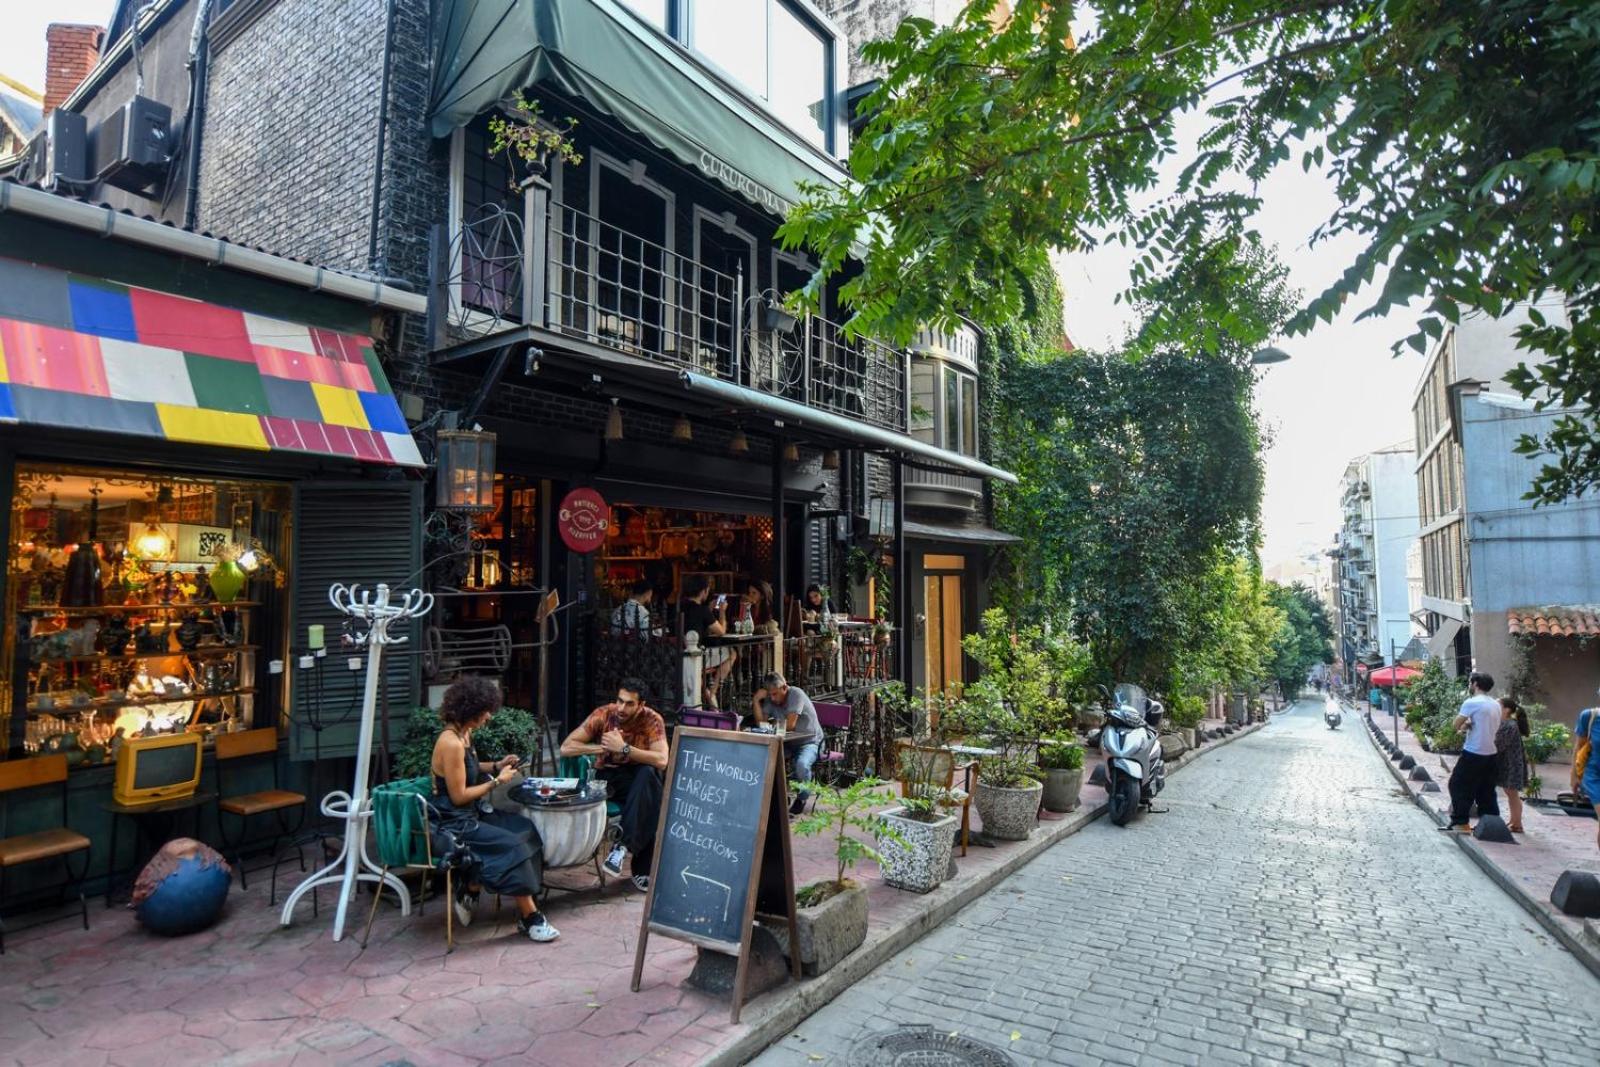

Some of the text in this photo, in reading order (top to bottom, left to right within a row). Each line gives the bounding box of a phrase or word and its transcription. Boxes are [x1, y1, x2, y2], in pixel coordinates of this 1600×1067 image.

[701, 151, 780, 211] ÇUKURCUMA
[683, 750, 711, 772] THE
[676, 774, 729, 805] LARGEST
[675, 797, 713, 825] TURTLE
[670, 822, 739, 863] COLLECTIONS
